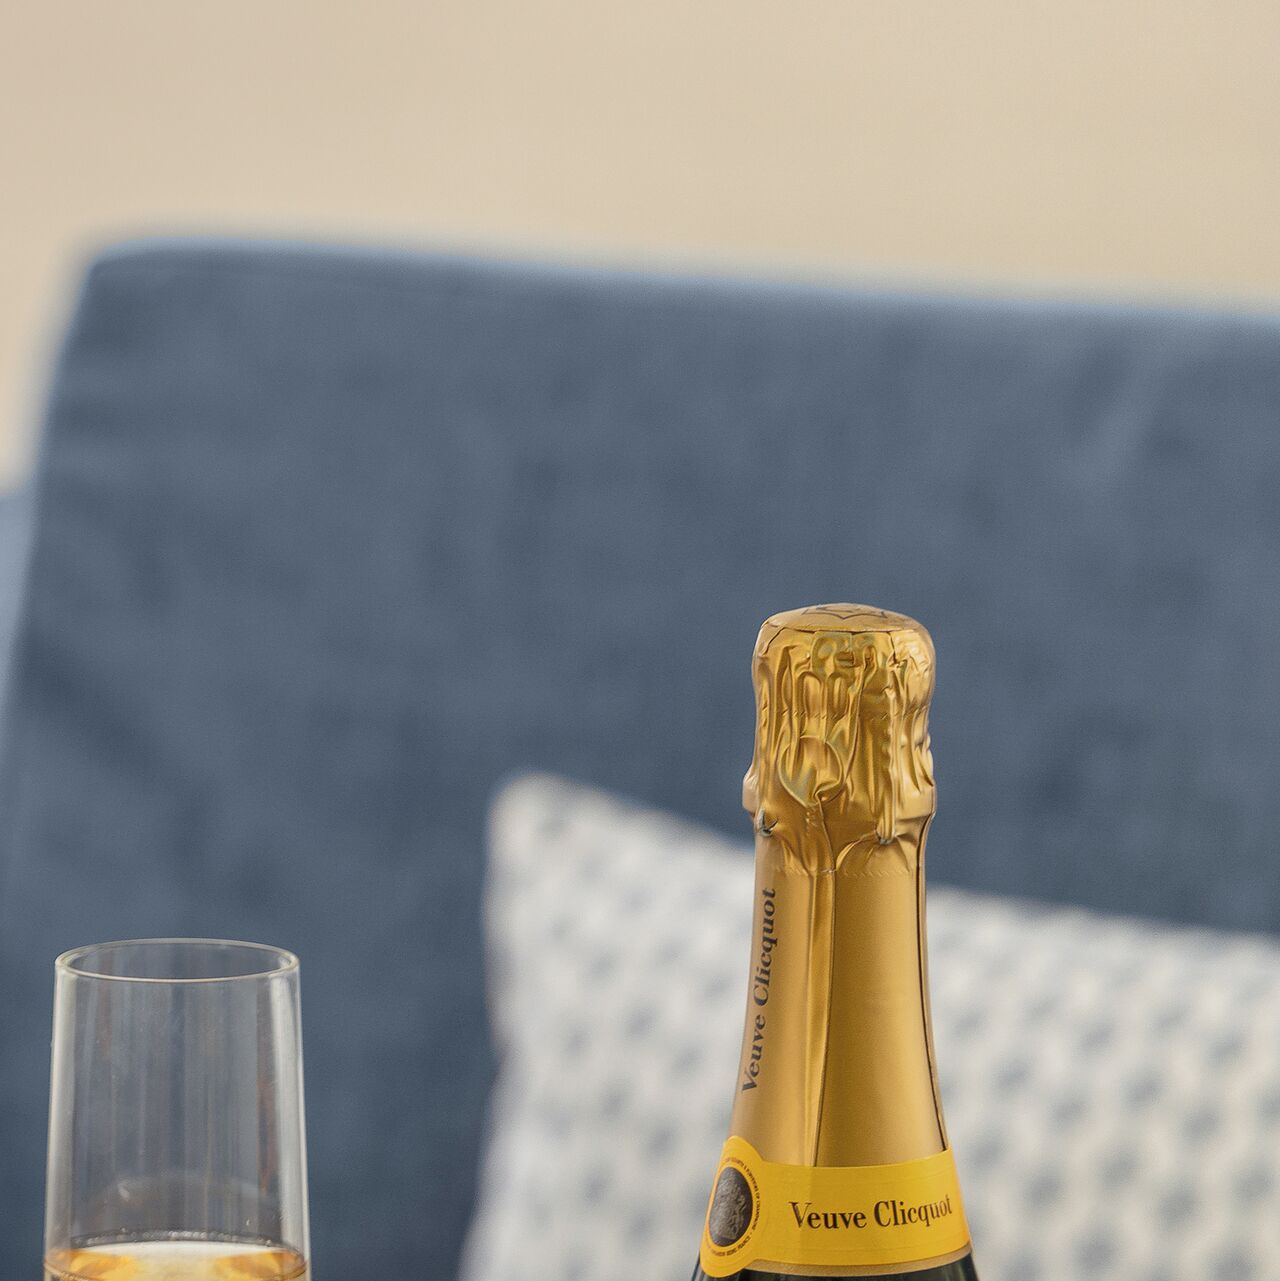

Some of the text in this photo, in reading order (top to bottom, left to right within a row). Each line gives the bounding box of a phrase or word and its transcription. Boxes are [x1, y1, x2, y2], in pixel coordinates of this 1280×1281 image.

[741, 887, 778, 1093] Veuve Clicquot
[789, 1194, 953, 1230] Veuve Clicquot
